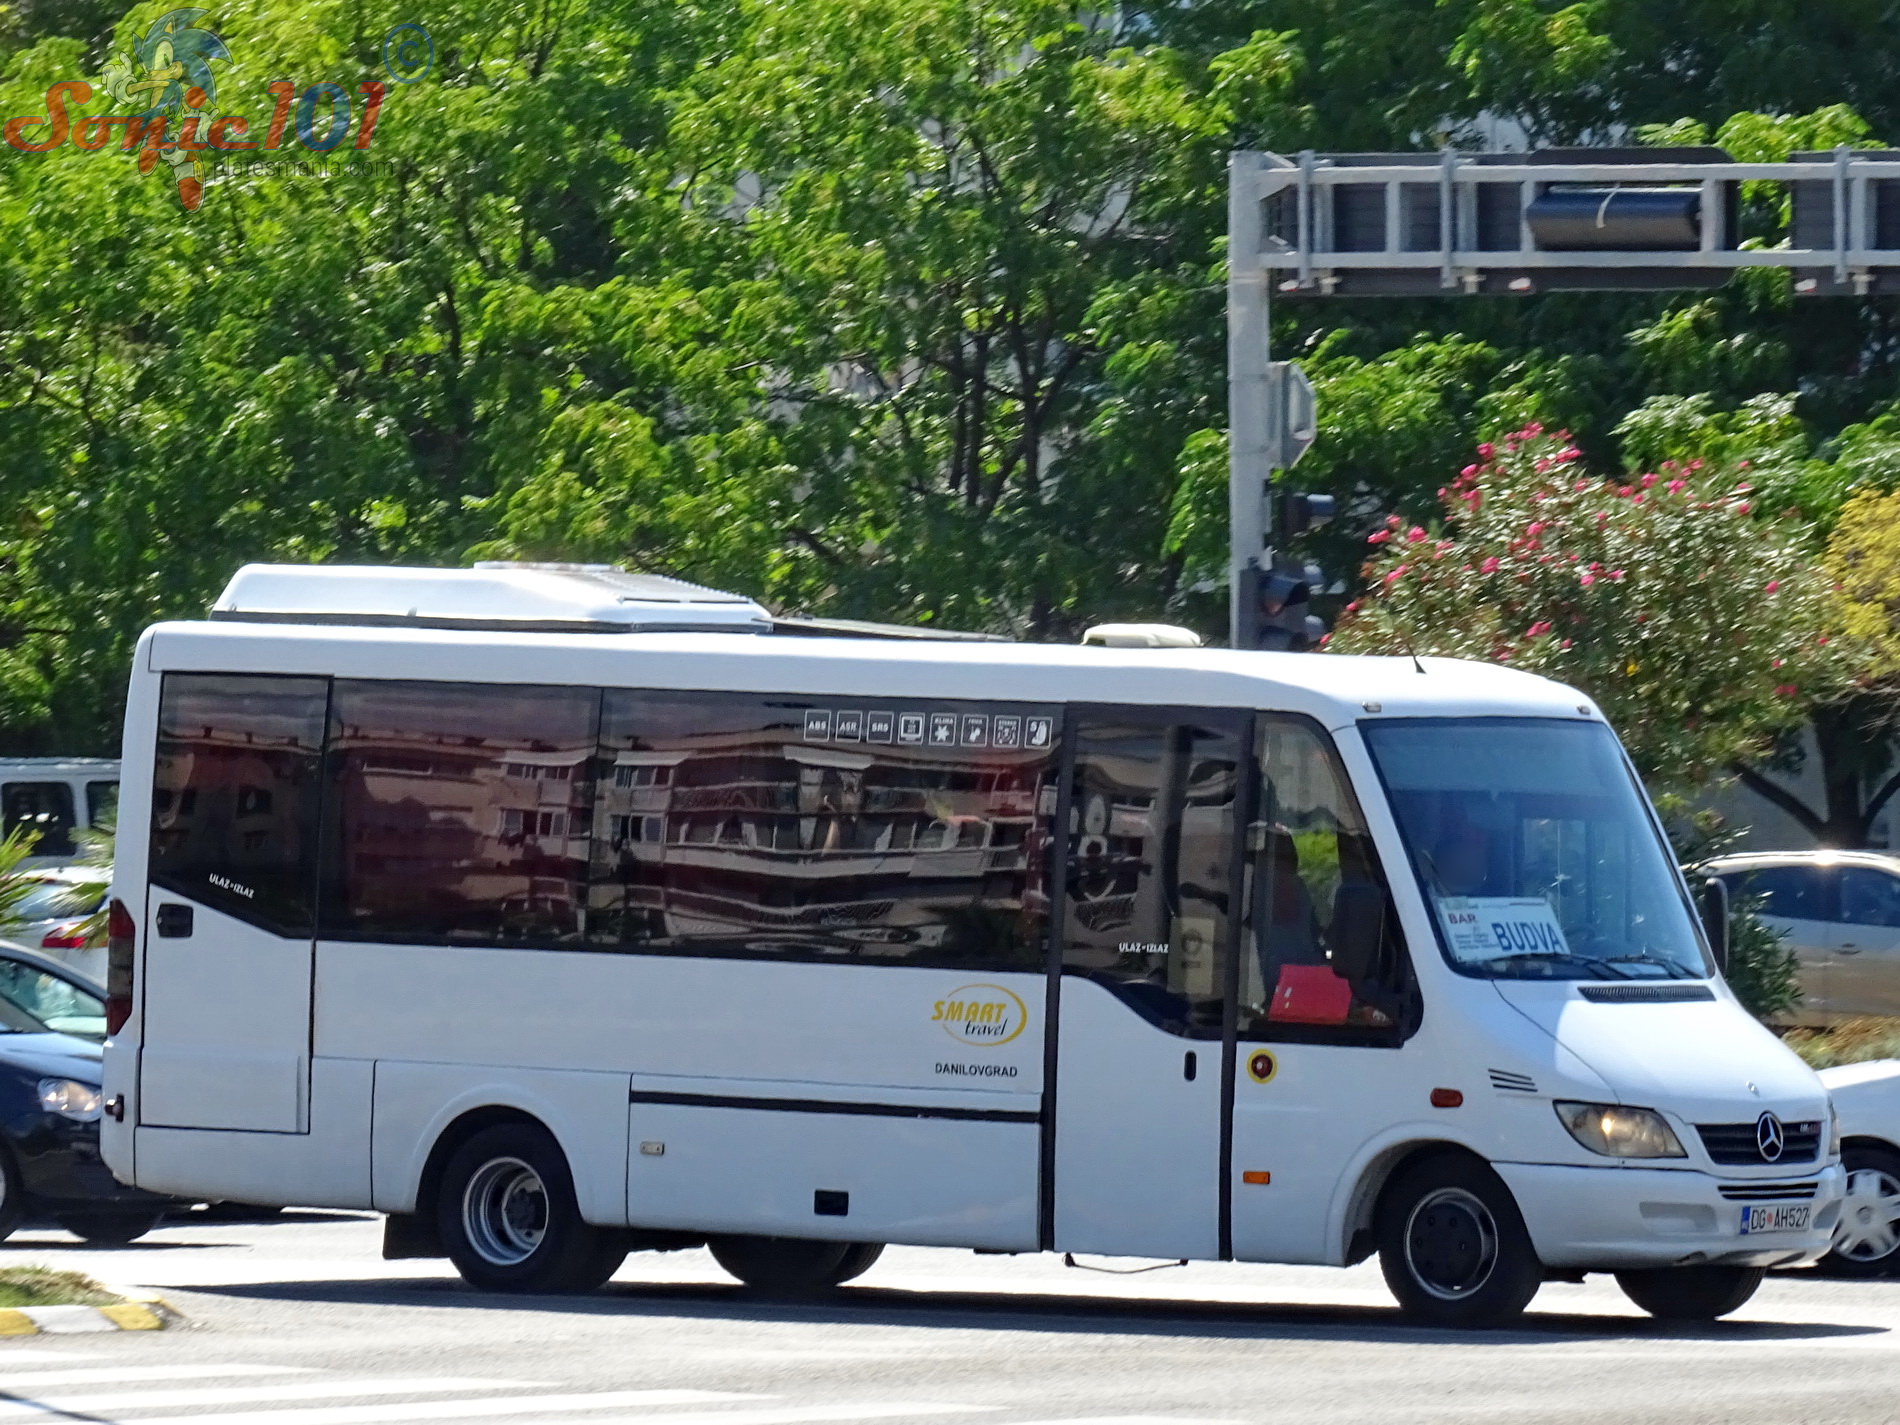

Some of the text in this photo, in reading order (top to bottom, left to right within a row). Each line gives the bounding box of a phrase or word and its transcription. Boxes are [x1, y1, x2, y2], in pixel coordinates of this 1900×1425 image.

[808, 720, 827, 731] ABS
[839, 721, 858, 732] ASR
[1448, 912, 1477, 924] BAR
[1491, 921, 1565, 952] BUDVA
[931, 999, 1007, 1023] SMART
[965, 1017, 1008, 1036] travel
[935, 1062, 1018, 1078] DANILOVGRAD
